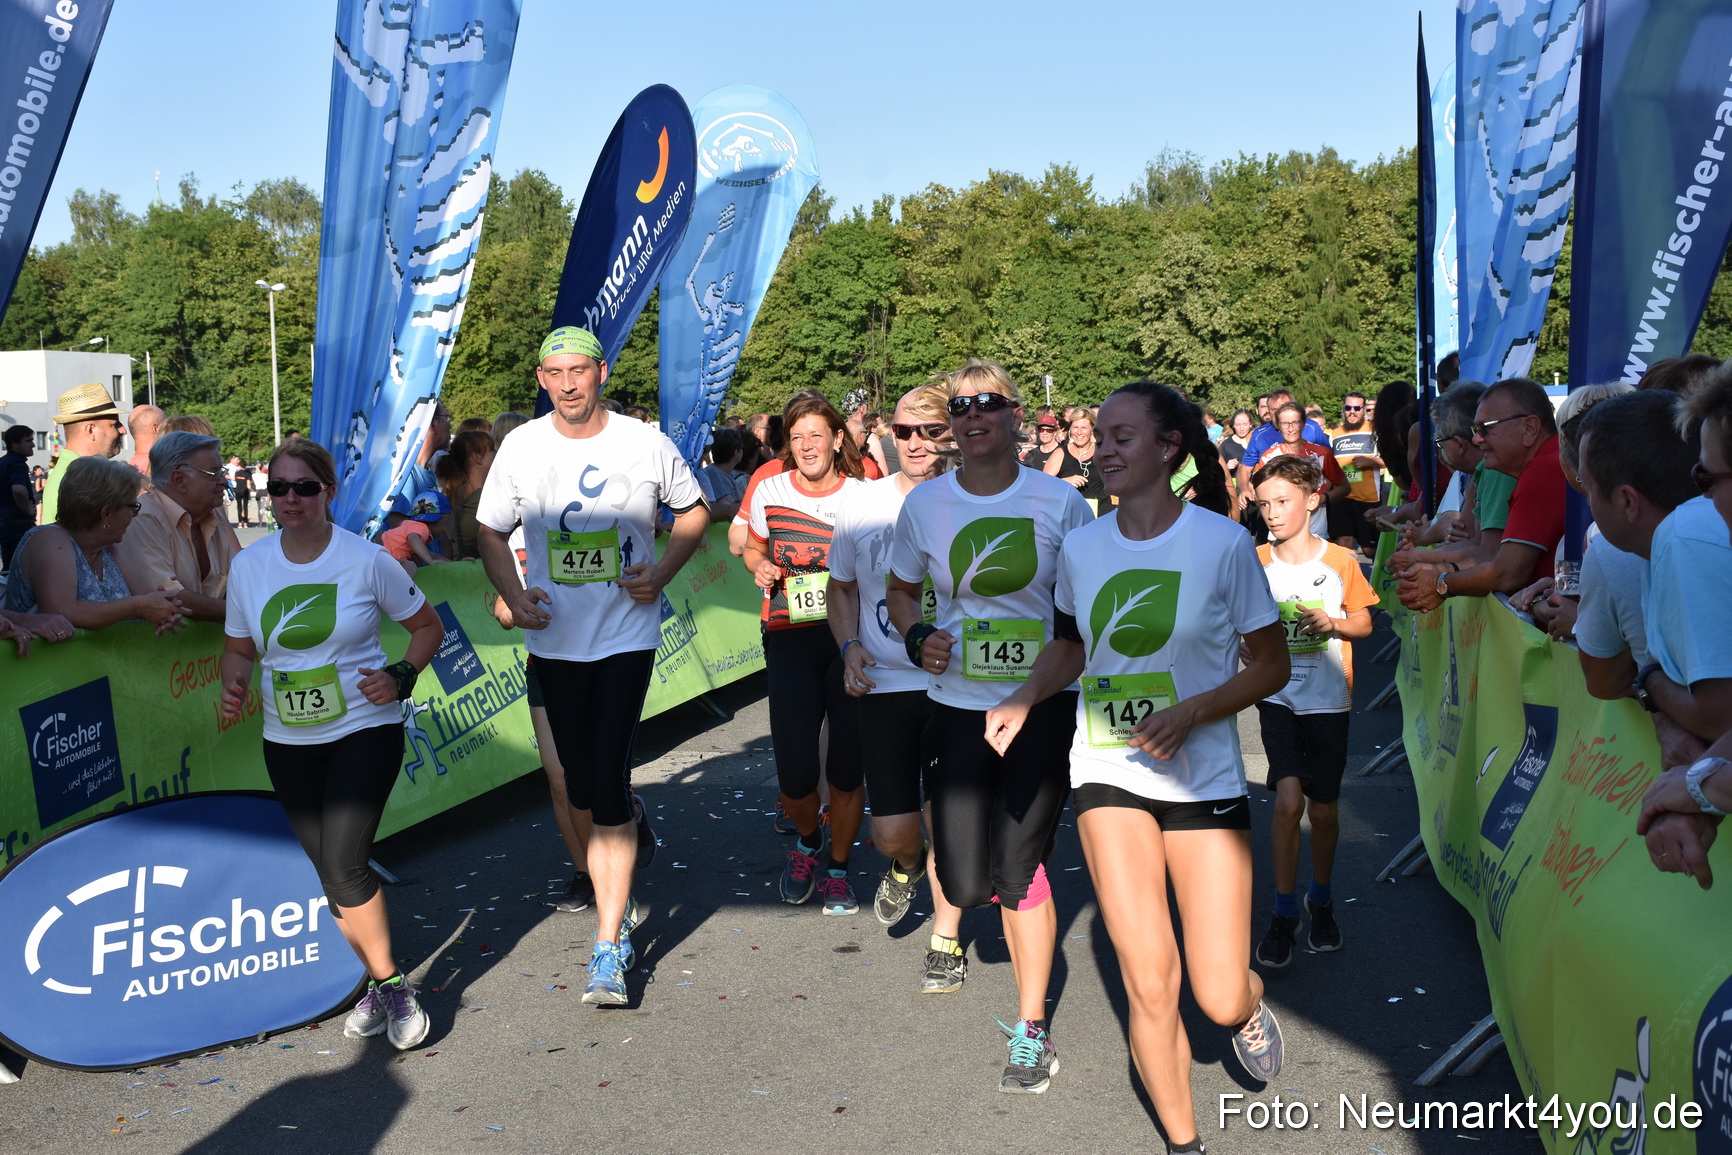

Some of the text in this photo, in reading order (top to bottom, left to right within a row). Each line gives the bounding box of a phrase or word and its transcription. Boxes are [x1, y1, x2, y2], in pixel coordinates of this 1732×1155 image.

[0, 0, 78, 240] utomobile.de
[715, 154, 798, 188] WECHSELSZENE
[609, 181, 686, 320] Druck und Medien
[583, 214, 648, 332] hmann
[562, 549, 604, 569] 474
[795, 589, 826, 609] 189
[972, 663, 1004, 671] Olejeklaus
[980, 641, 1025, 664] 143
[285, 688, 325, 711] 173
[306, 707, 330, 716] Sabrina
[428, 646, 527, 745] firmenlauf
[1103, 699, 1154, 728] 142
[46, 721, 102, 759] Fischer
[55, 741, 101, 770] AUTOMOBILE
[450, 721, 499, 765] neumarkt
[92, 895, 328, 976] Fischer
[123, 942, 320, 1002] AUTOMOBILE
